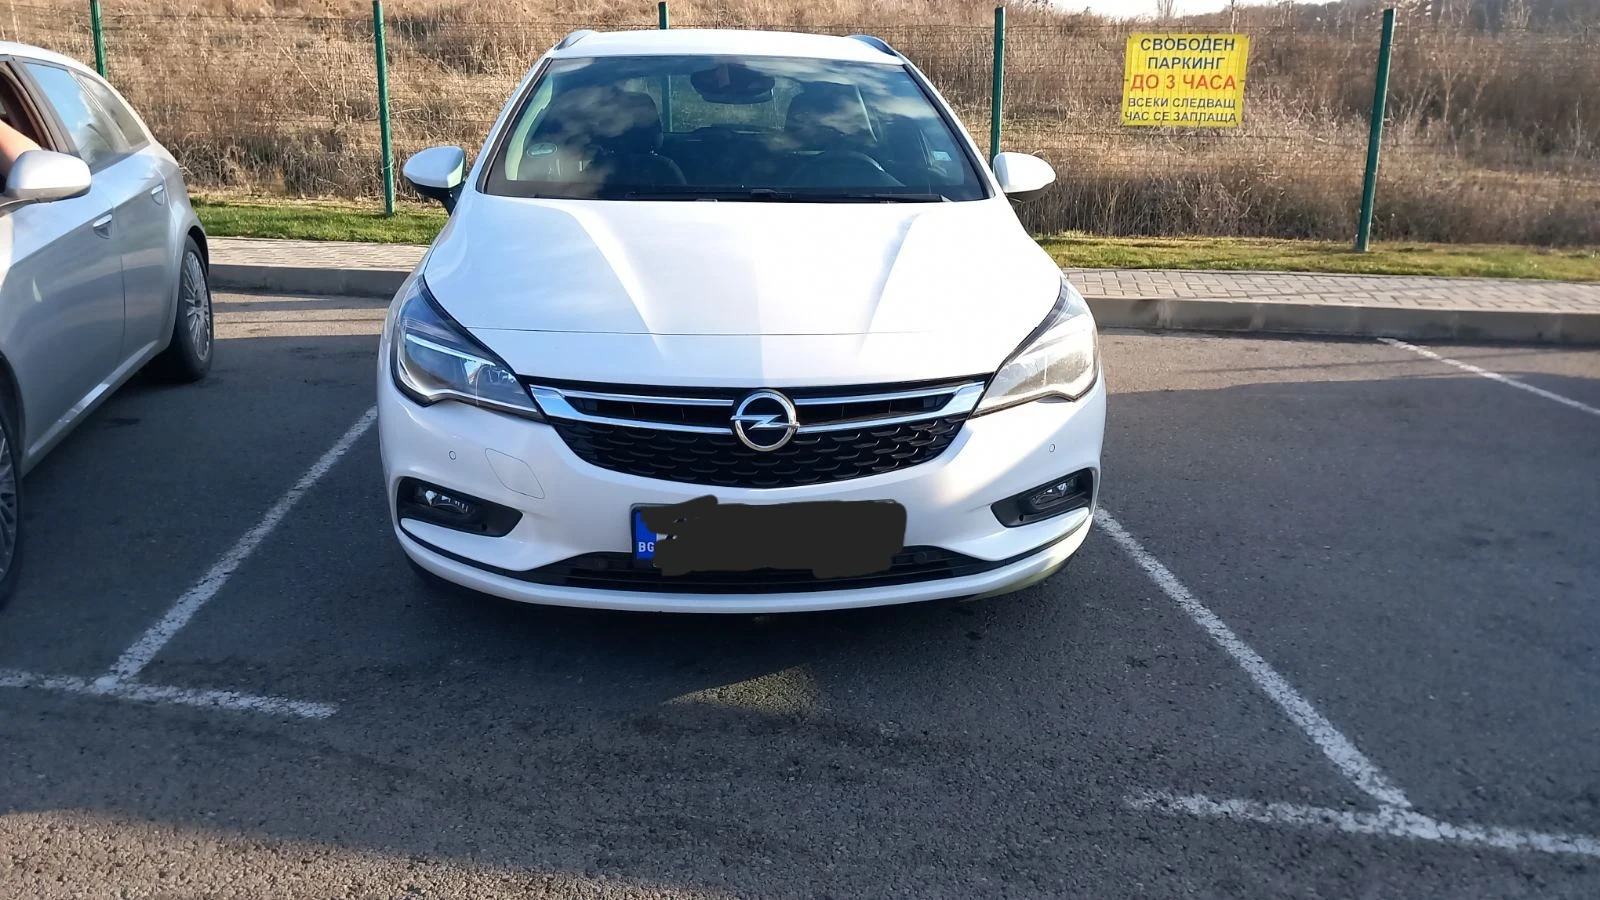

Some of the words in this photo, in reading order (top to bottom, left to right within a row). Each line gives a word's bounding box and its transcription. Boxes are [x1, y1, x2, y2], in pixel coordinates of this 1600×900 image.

[1140, 38, 1235, 53] СВОБОДЕН
[1147, 57, 1226, 70] ПАРКИНГ
[1130, 74, 1159, 92] ДО
[1165, 74, 1176, 90] 3
[1182, 74, 1236, 90] ЧАСА
[1128, 97, 1169, 108] ВСЕКИ
[1172, 97, 1236, 109] СЛЕДВАЩ
[1124, 111, 1150, 121] ЧАС
[1153, 111, 1170, 121] СЕ
[1173, 112, 1237, 123] ЗАПЛАЩА
[638, 541, 655, 553] BG
